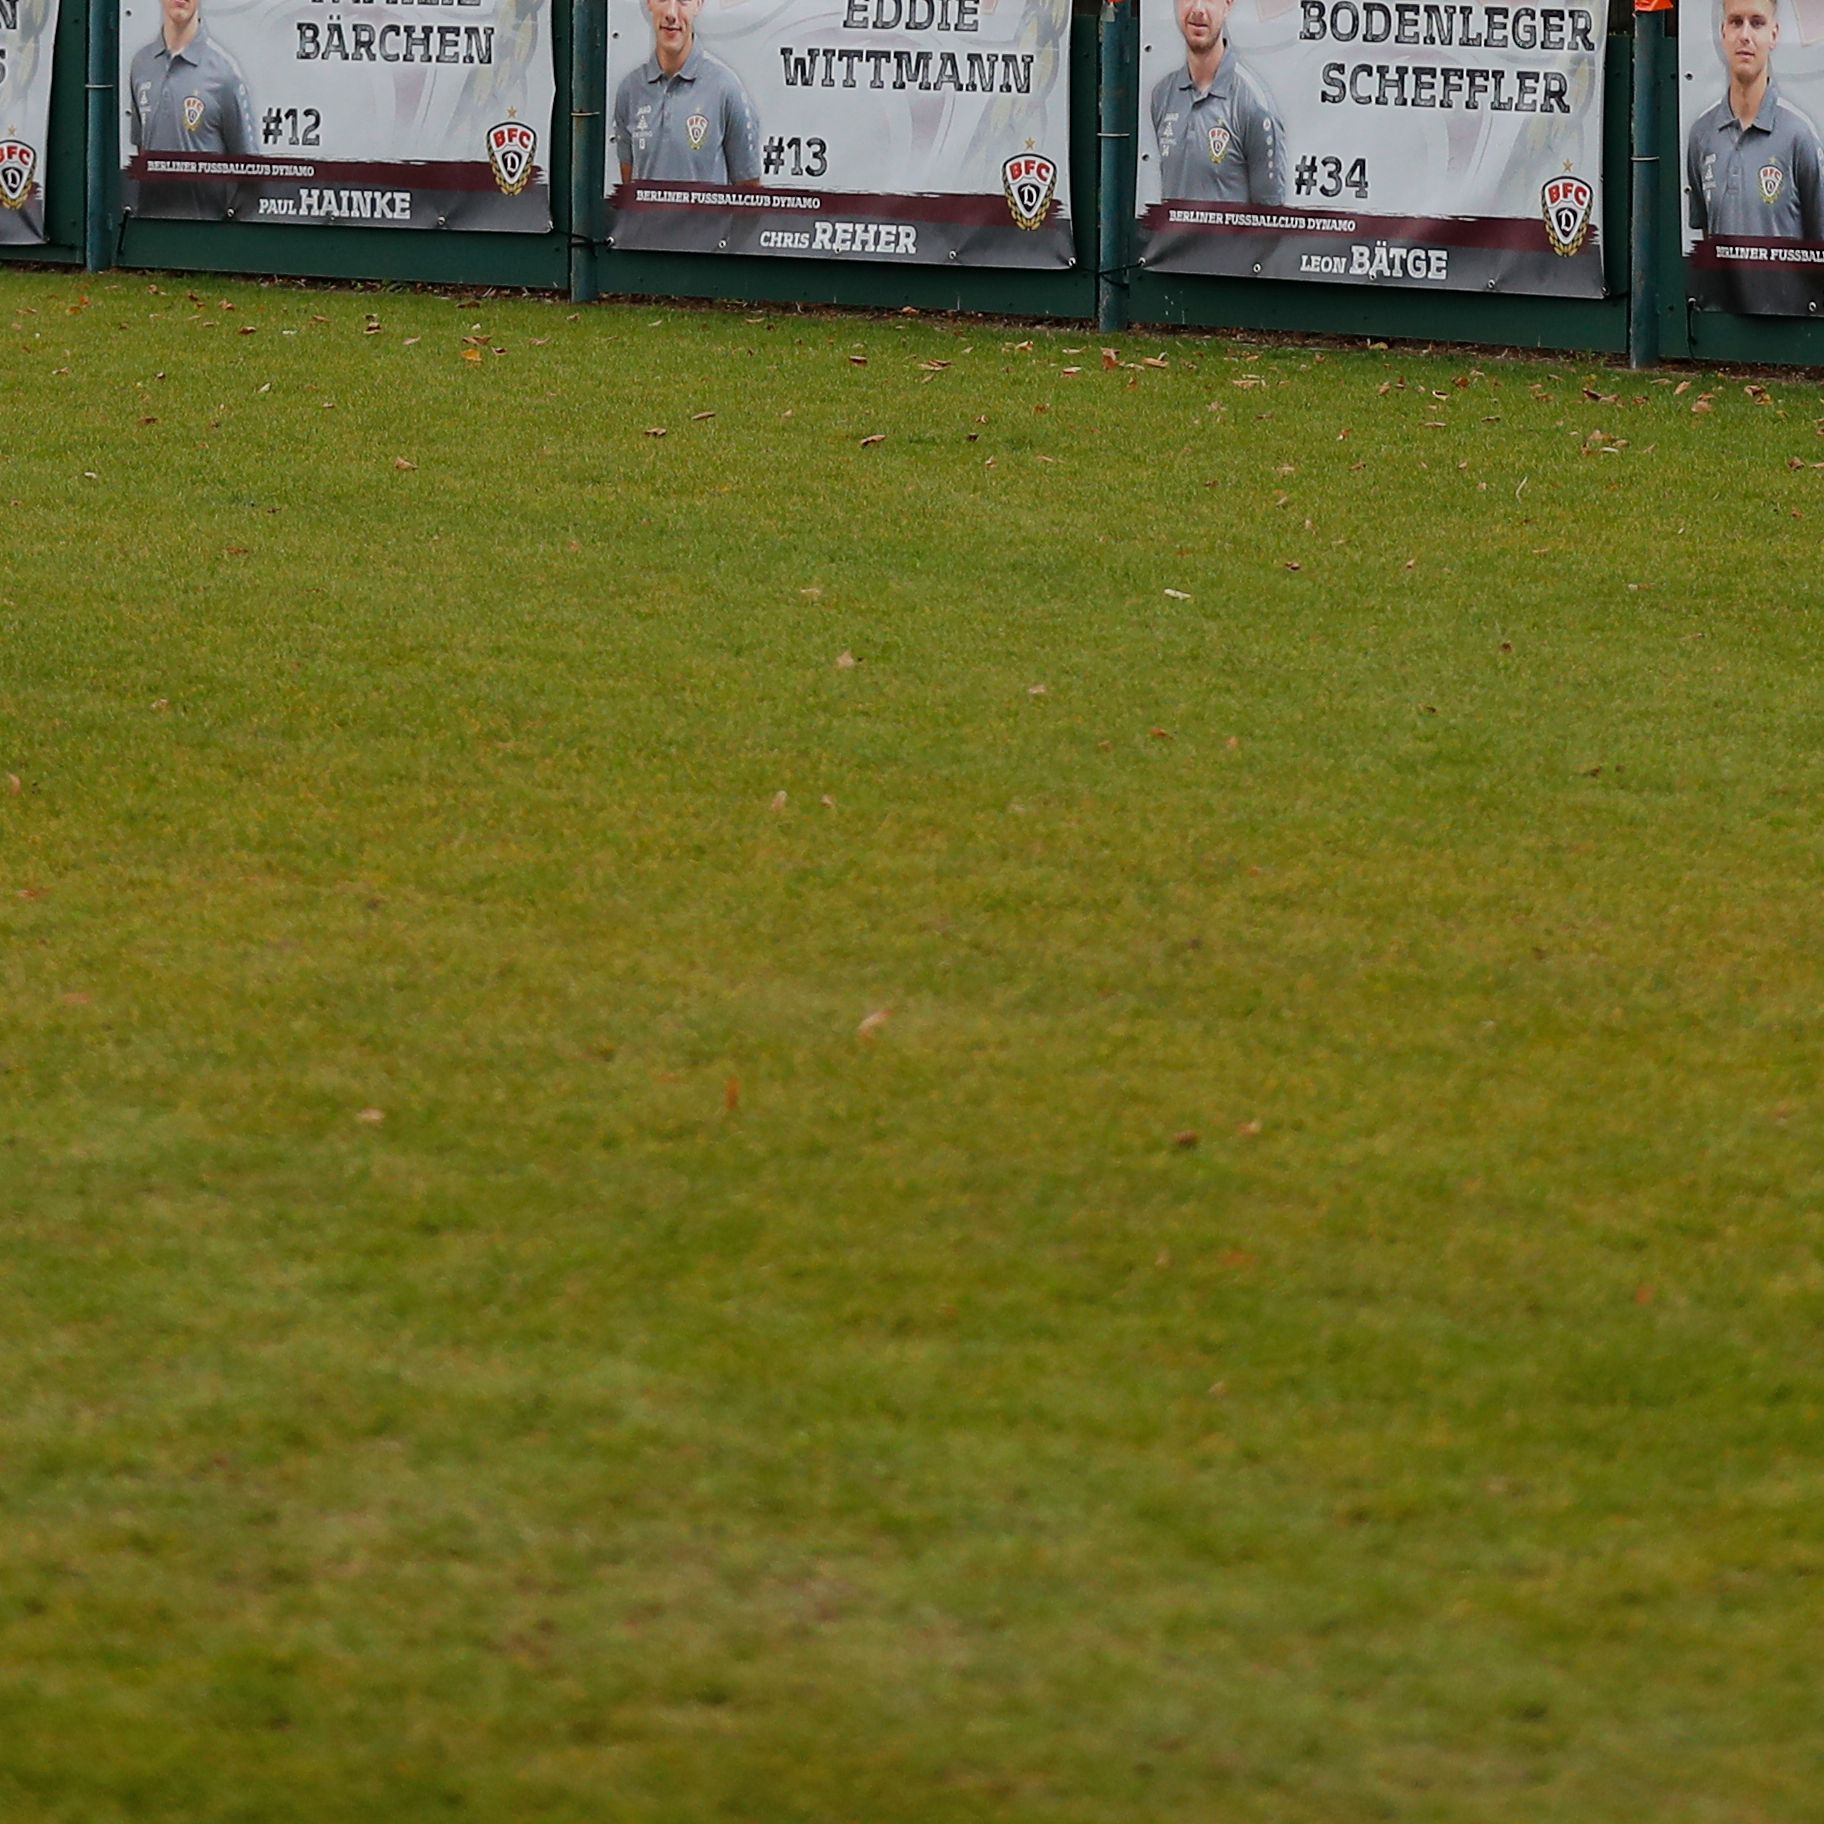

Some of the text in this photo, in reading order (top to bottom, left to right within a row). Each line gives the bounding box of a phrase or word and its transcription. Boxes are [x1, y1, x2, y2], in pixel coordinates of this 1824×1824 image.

[296, 14, 495, 65] BÄRCHEN
[1299, 0, 1594, 52] BODENLEGER
[780, 47, 1034, 93] WITTMANN
[1320, 63, 1570, 113] SCHEFFLER
[262, 107, 322, 146] #12
[492, 127, 532, 150] BFC
[147, 161, 314, 177] BERLINER FUSSBALLCLUB DYNAMO
[763, 136, 828, 177] #13
[1009, 159, 1051, 182] BFC
[1294, 155, 1369, 199] #34
[259, 188, 412, 219] PAUL HAINKE
[636, 190, 820, 209] BERLINER FUSSBALLCLUB DYNAMO
[1547, 182, 1589, 207] BFC
[760, 221, 917, 254] CHRIS REHER
[1169, 210, 1355, 232] BERLINER FUSSBALLCLUB DYNAMO
[1300, 241, 1448, 280] LEON BÄTGE
[1716, 246, 1768, 260] BERLINER
